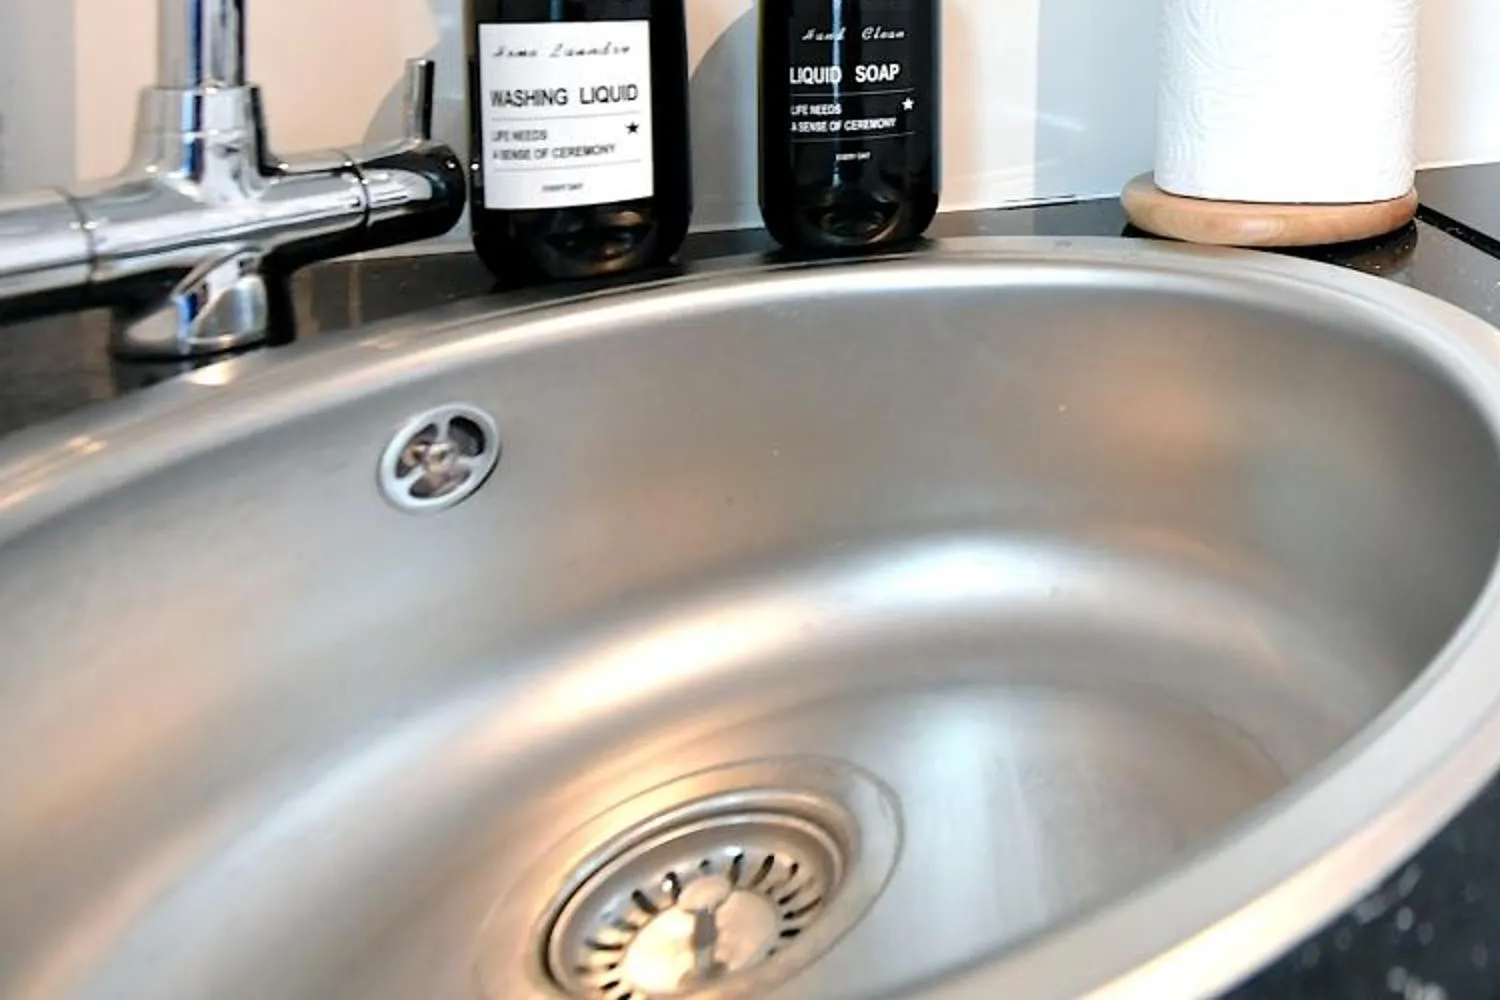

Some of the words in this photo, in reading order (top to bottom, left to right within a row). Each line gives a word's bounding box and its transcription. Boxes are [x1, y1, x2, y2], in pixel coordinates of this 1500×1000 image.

[861, 26, 905, 40] Clean
[789, 65, 843, 85] LIQUID
[855, 63, 900, 83] SOAP
[490, 87, 569, 108] WASHING
[579, 83, 640, 105] LIQUID
[790, 103, 808, 116] LIFE
[809, 103, 842, 115] NEEDS
[798, 120, 828, 133] SENSE
[828, 119, 841, 132] OF
[843, 117, 897, 131] CEREMONY
[492, 130, 509, 142] LIFE
[512, 129, 548, 142] NEEDS
[500, 148, 531, 161] SENSE
[534, 147, 548, 160] OF
[551, 143, 616, 160] CEREMONY
